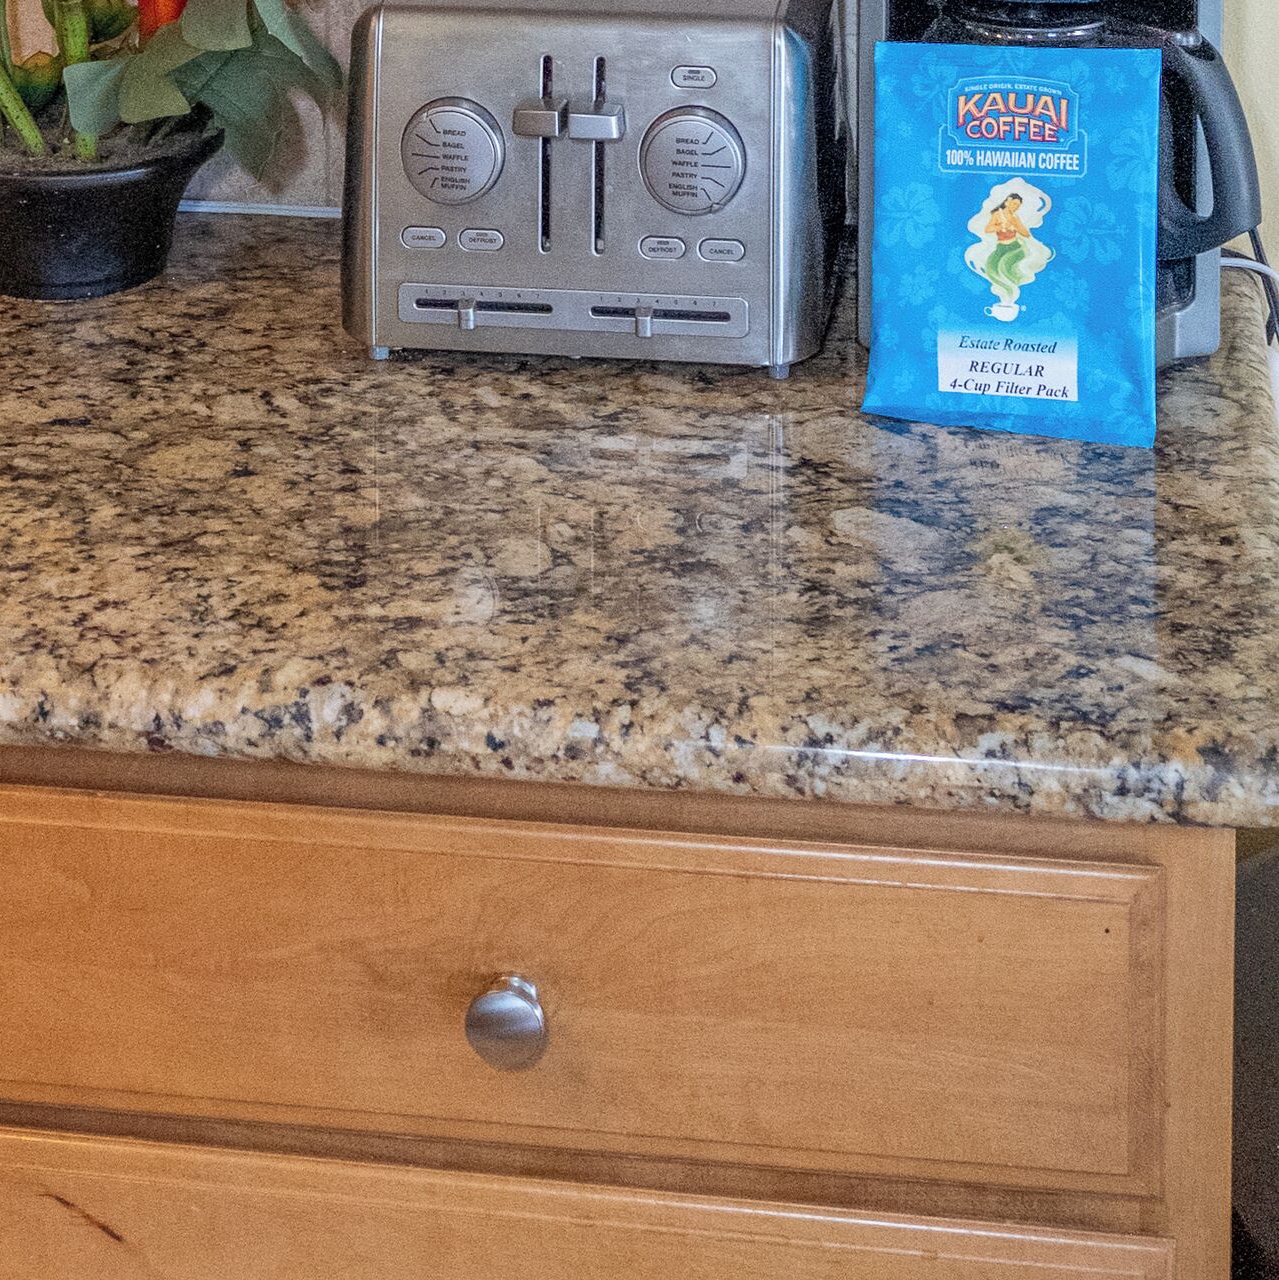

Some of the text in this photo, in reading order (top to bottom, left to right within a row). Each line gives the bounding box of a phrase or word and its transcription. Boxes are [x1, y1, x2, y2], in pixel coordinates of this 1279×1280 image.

[682, 74, 706, 82] SINGLE
[957, 91, 1069, 132] KAUAI
[442, 129, 467, 137] BREAD
[965, 116, 1059, 143] COFFEE
[675, 137, 700, 145] BREAD
[675, 148, 699, 156] BAGEL
[441, 154, 469, 162] WAFFLE
[945, 149, 1080, 171] 100% HAWAIIAN COFFEE
[671, 160, 699, 168] WAFFLE
[440, 166, 467, 174] PASTRY
[671, 171, 698, 180] PASTRY
[440, 176, 471, 184] ENGLISH
[440, 183, 467, 191] MUFFIN
[668, 182, 698, 191] ENGLISH
[671, 190, 698, 198] MUFFIN
[411, 234, 436, 242] CANCEL
[708, 247, 735, 256] CANCEL
[959, 335, 1058, 354] Estate Roasted
[969, 360, 1045, 377] REGULAR
[950, 378, 1069, 399] 4-Cup Filter Pack
